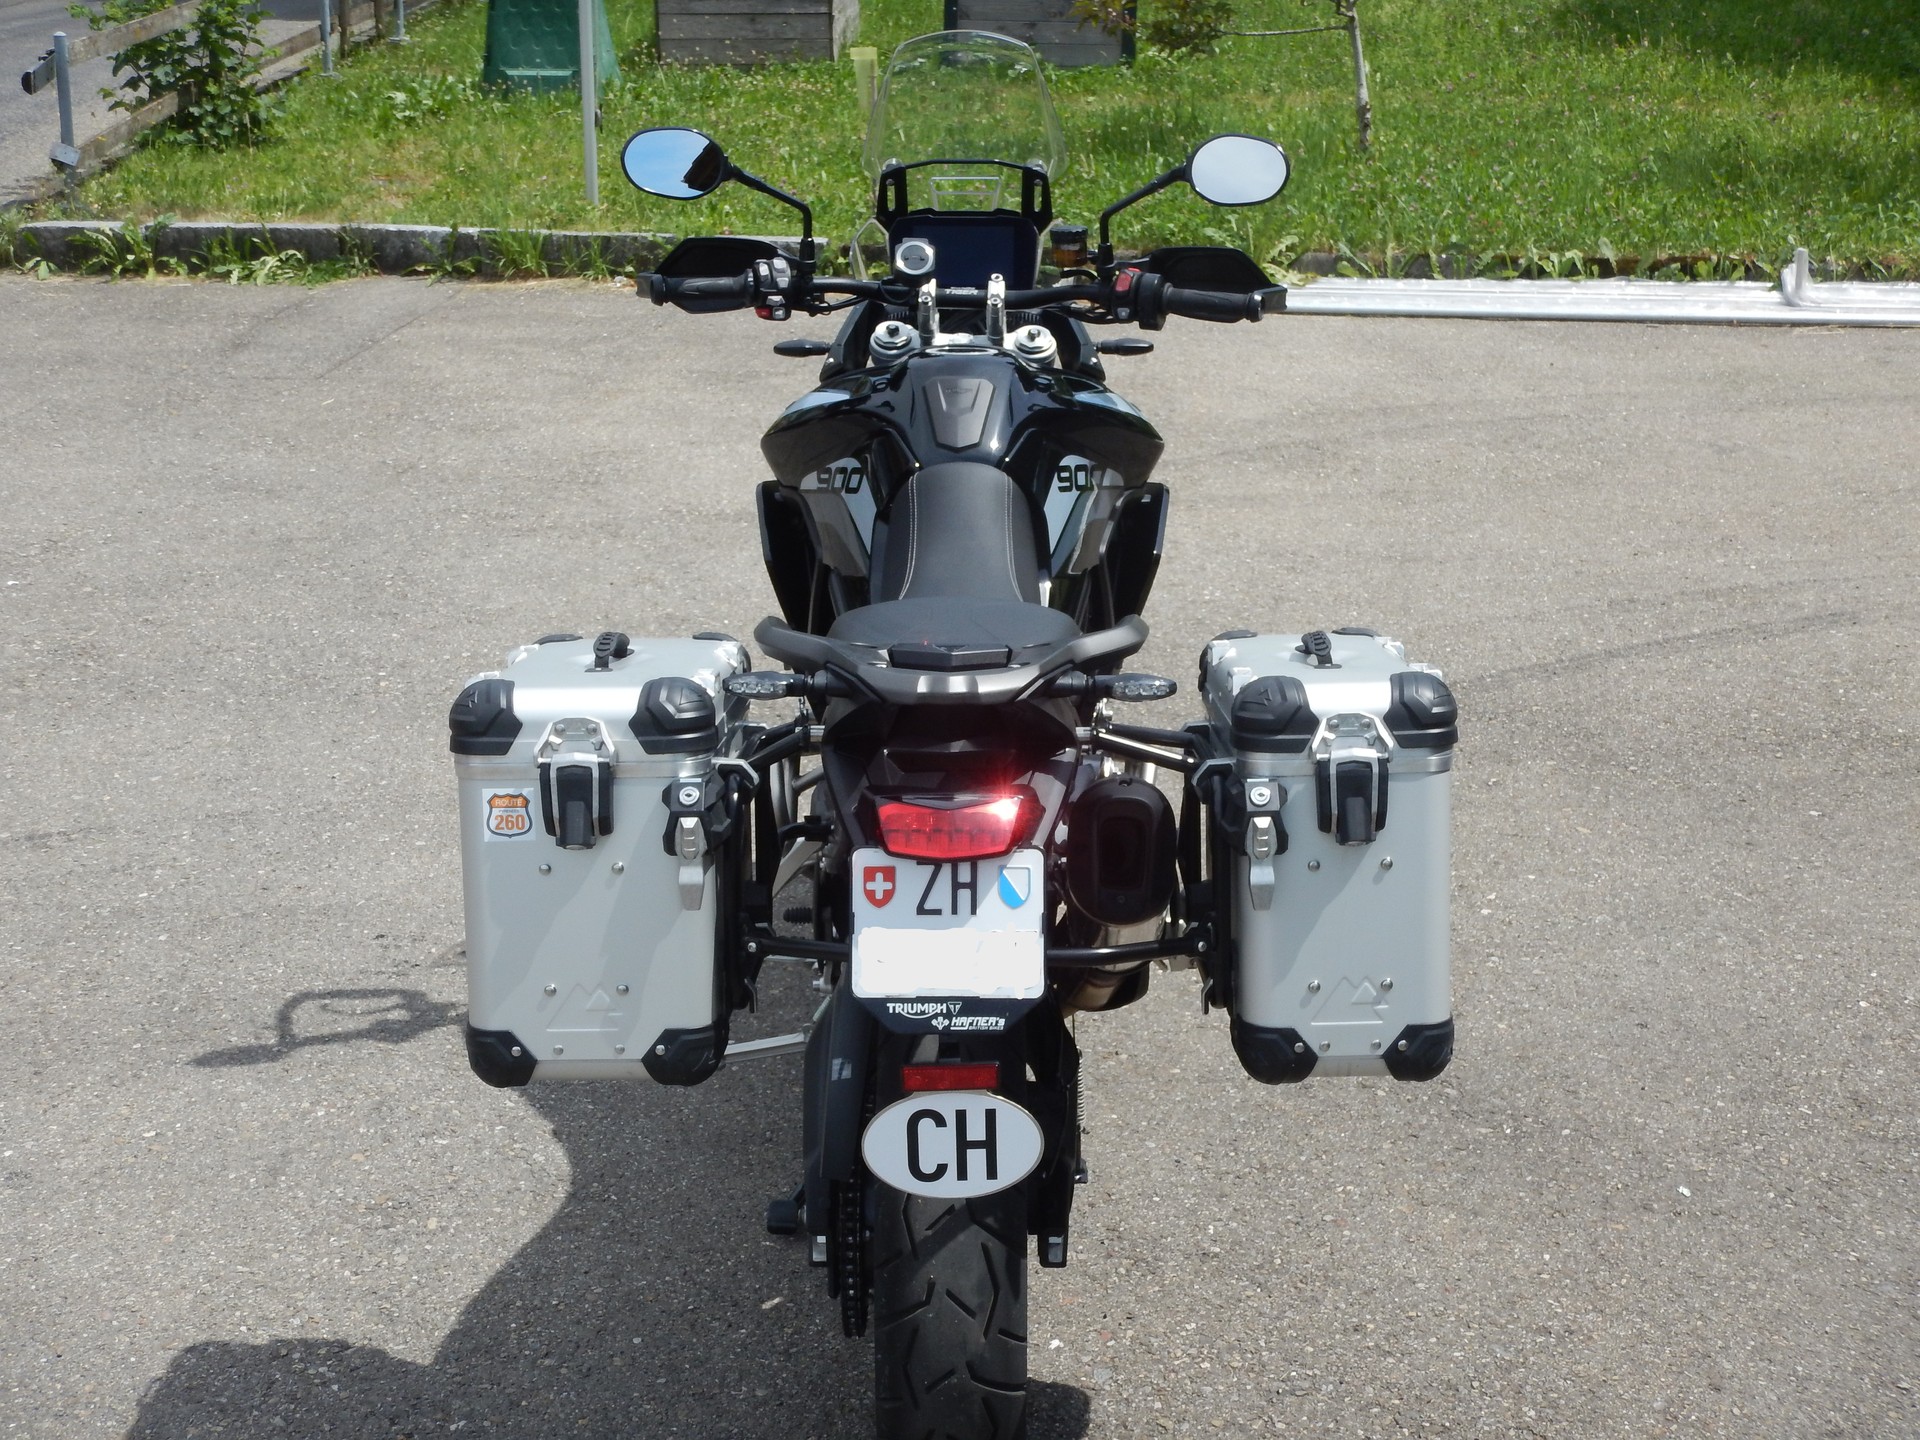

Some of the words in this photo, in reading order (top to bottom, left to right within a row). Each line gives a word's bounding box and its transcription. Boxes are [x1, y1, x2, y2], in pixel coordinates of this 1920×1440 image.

[817, 466, 864, 494] 900
[495, 798, 523, 807] ROUTE
[494, 814, 526, 831] 260
[916, 860, 978, 916] ZH
[886, 1003, 947, 1018] TRIUMPH
[906, 1108, 998, 1183] CH
